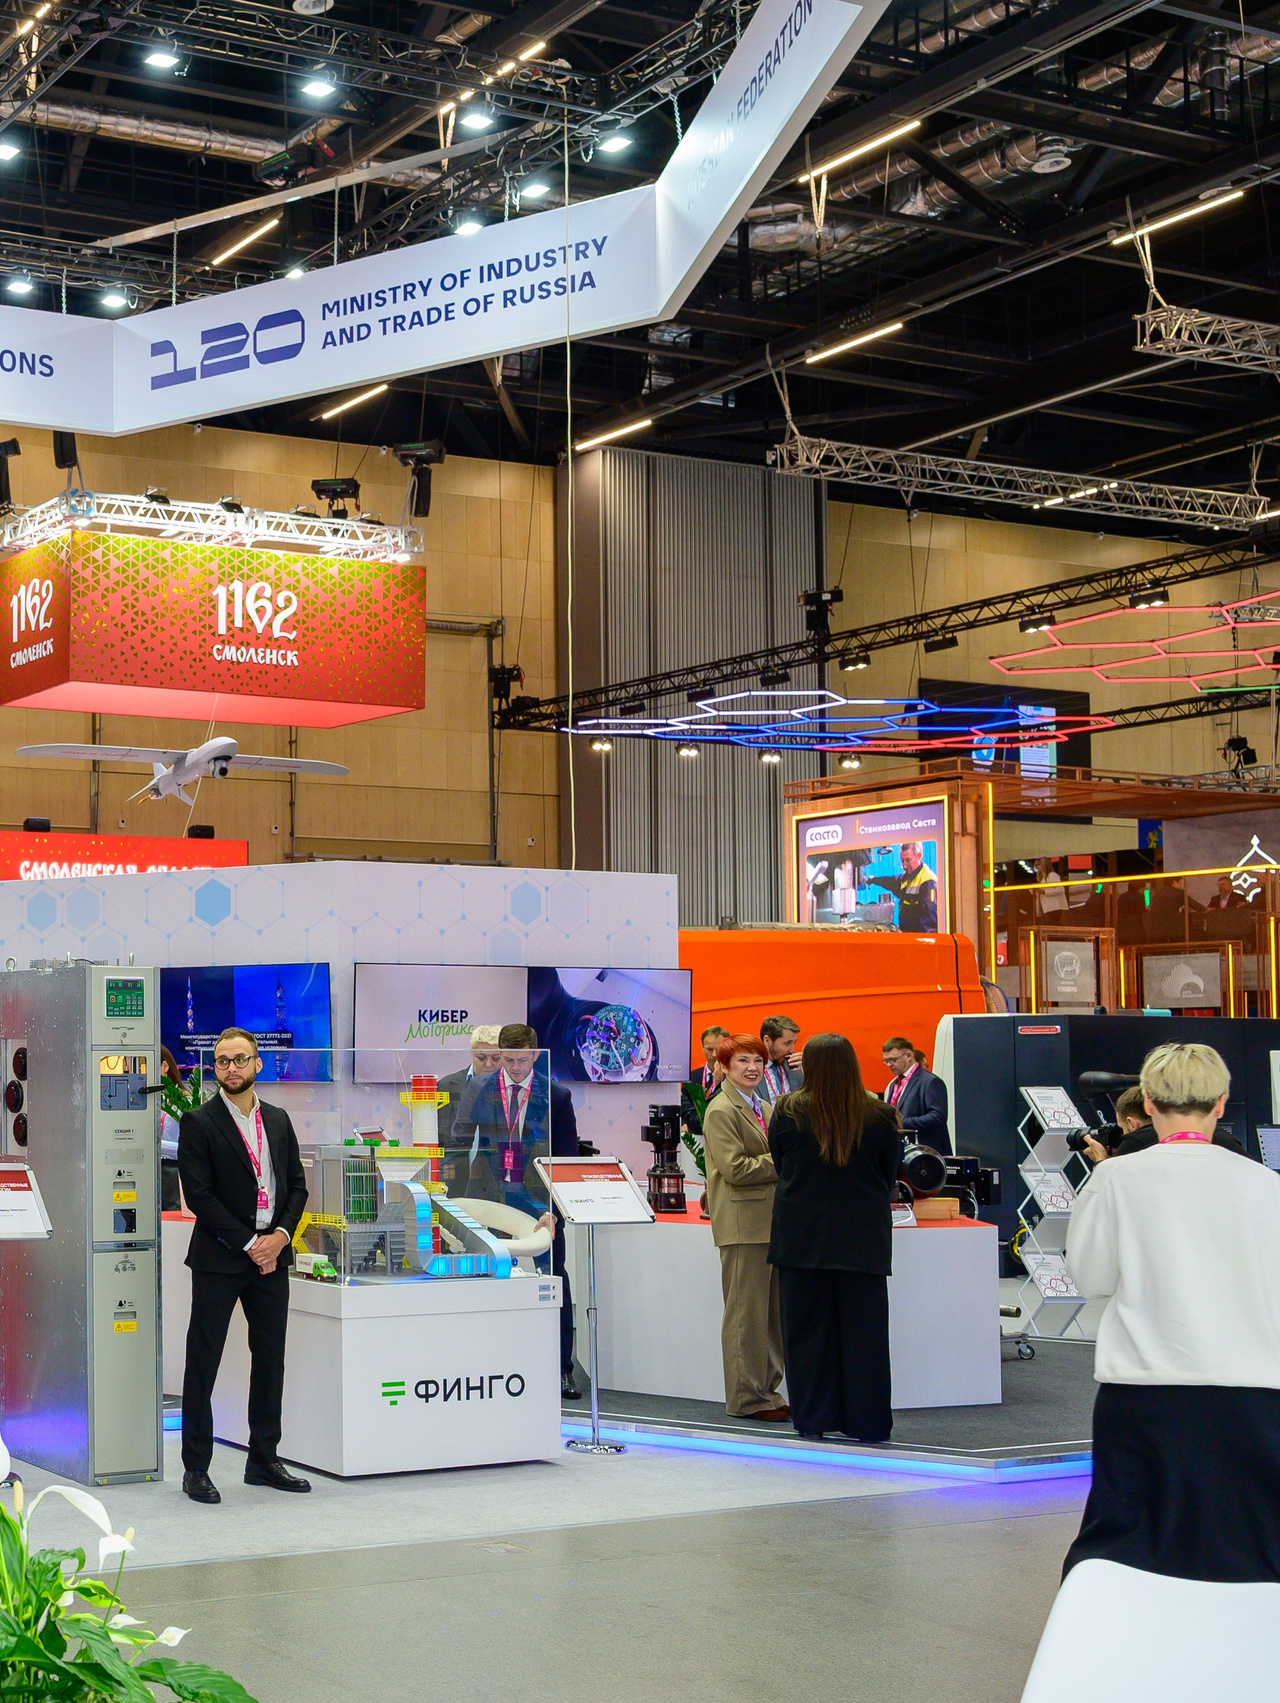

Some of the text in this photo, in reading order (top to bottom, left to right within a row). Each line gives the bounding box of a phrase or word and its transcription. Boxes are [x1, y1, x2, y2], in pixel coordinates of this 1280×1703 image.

[736, 0, 813, 131] FEDERATION
[321, 236, 608, 319] MINISTRY OF INDUSTRY
[322, 271, 597, 350] AND TRADE OF RUSSIA
[151, 308, 304, 390] 120
[10, 578, 54, 643] 1162
[212, 579, 298, 640] 1162
[10, 638, 54, 669] СМОЛЕНСК
[213, 644, 299, 667] СМОЛЕНСК
[858, 818, 937, 835] Станкозавод Саста
[418, 1009, 469, 1023] КИБЕР
[413, 1373, 526, 1404] ФИНГО
